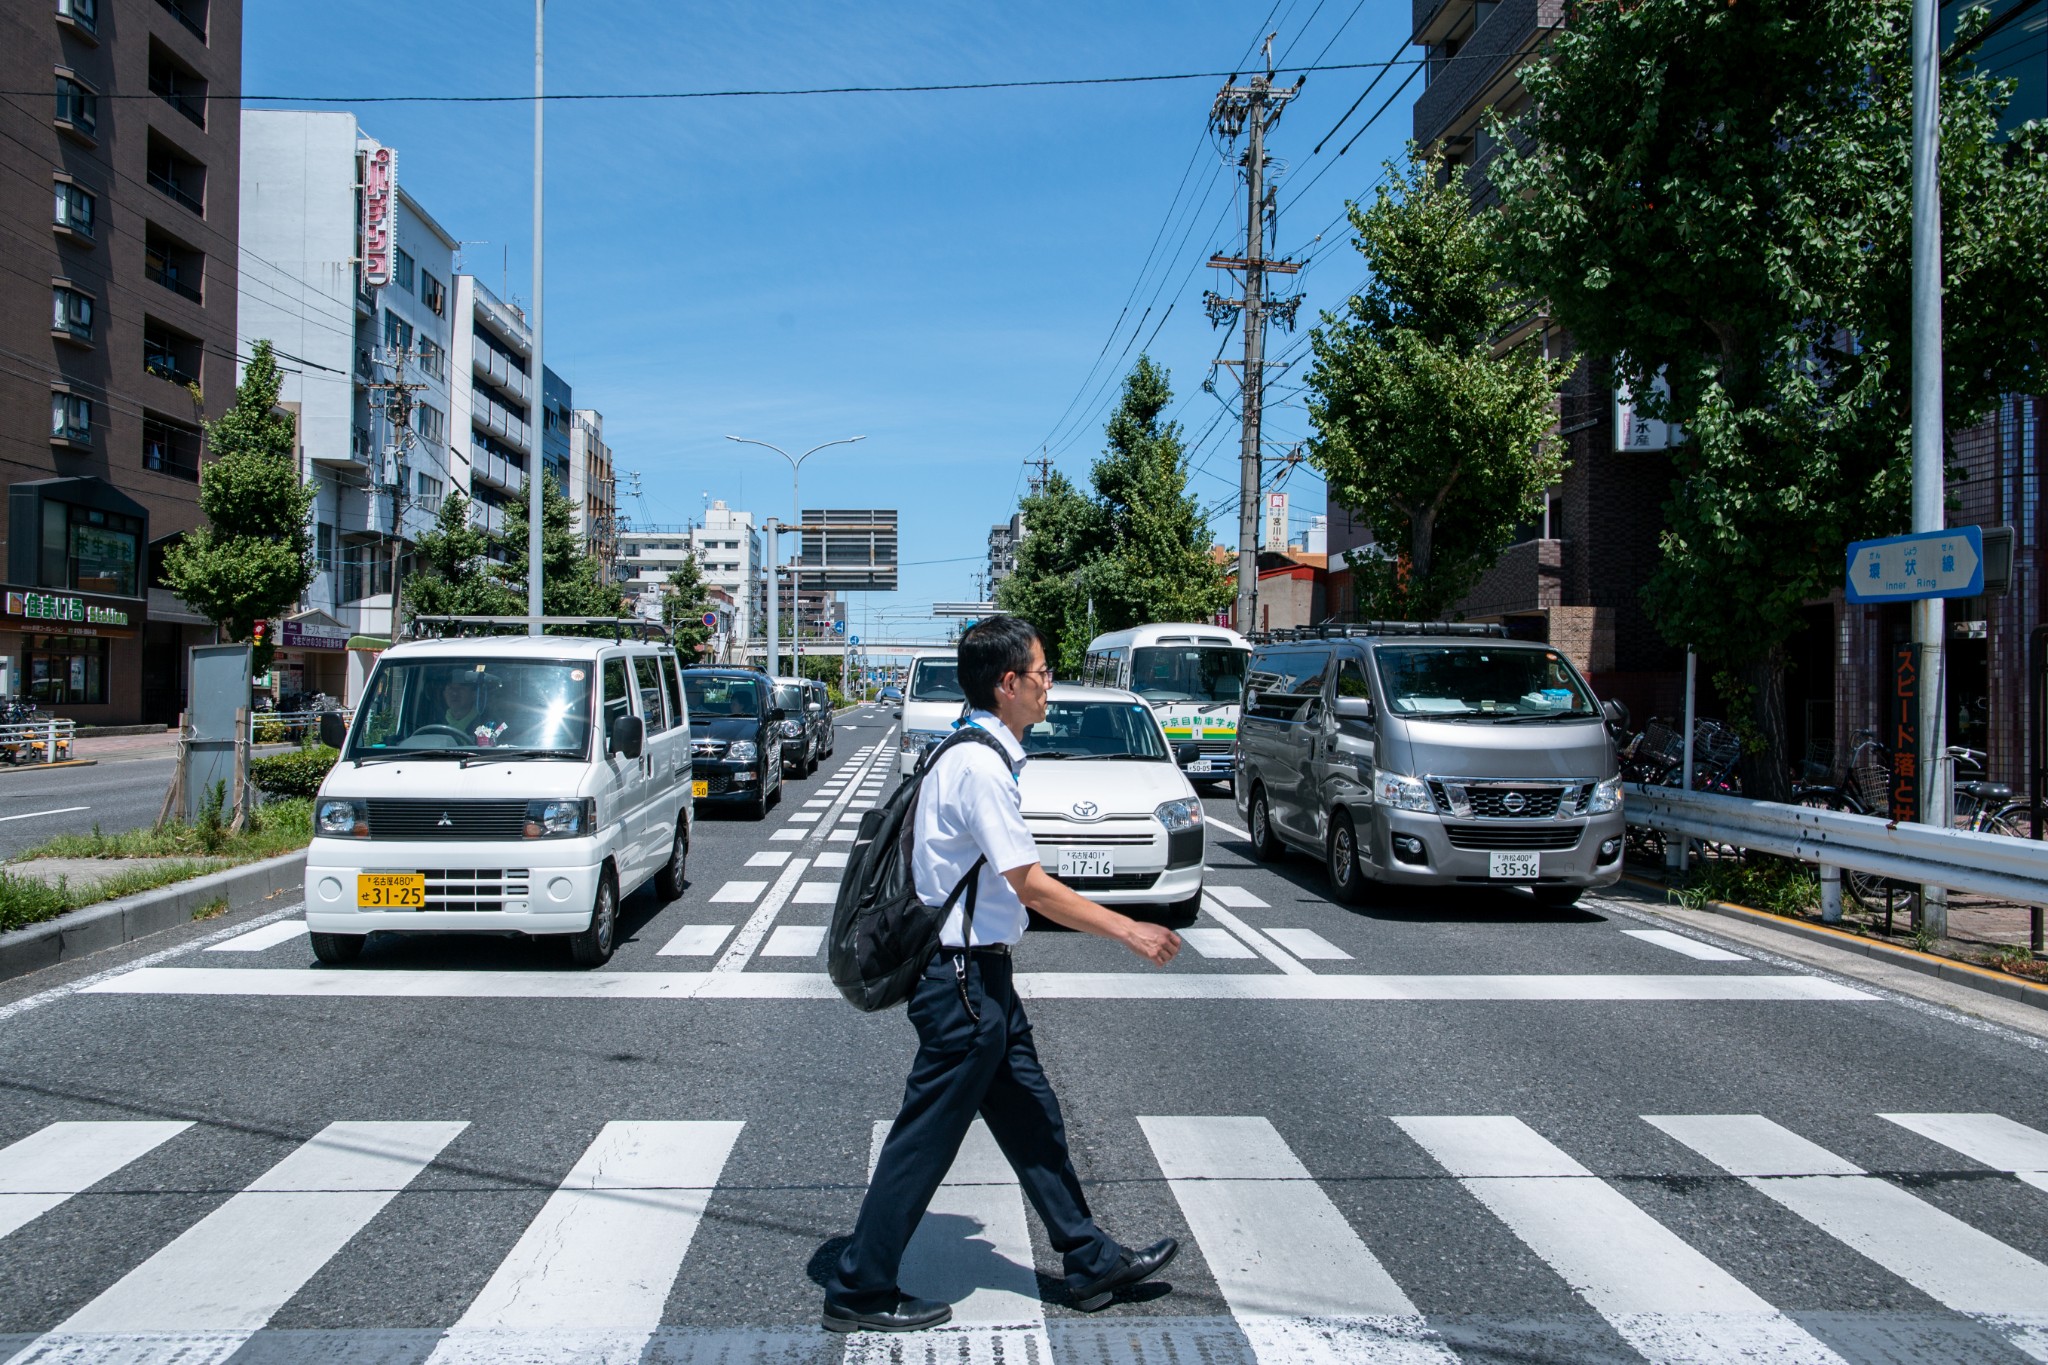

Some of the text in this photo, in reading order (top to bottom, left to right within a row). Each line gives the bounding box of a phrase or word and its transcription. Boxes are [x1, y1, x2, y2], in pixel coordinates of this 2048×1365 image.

[367, 149, 390, 274] パチンコ
[1272, 517, 1282, 536] 宮川
[1886, 578, 1937, 590] Inner Ring
[25, 592, 128, 625] 住まいる Station
[1892, 651, 1915, 822] スピード落とせ
[1073, 860, 1110, 875] 17-16
[1492, 863, 1537, 876] て 35-96
[361, 887, 421, 905] せ 31-25
